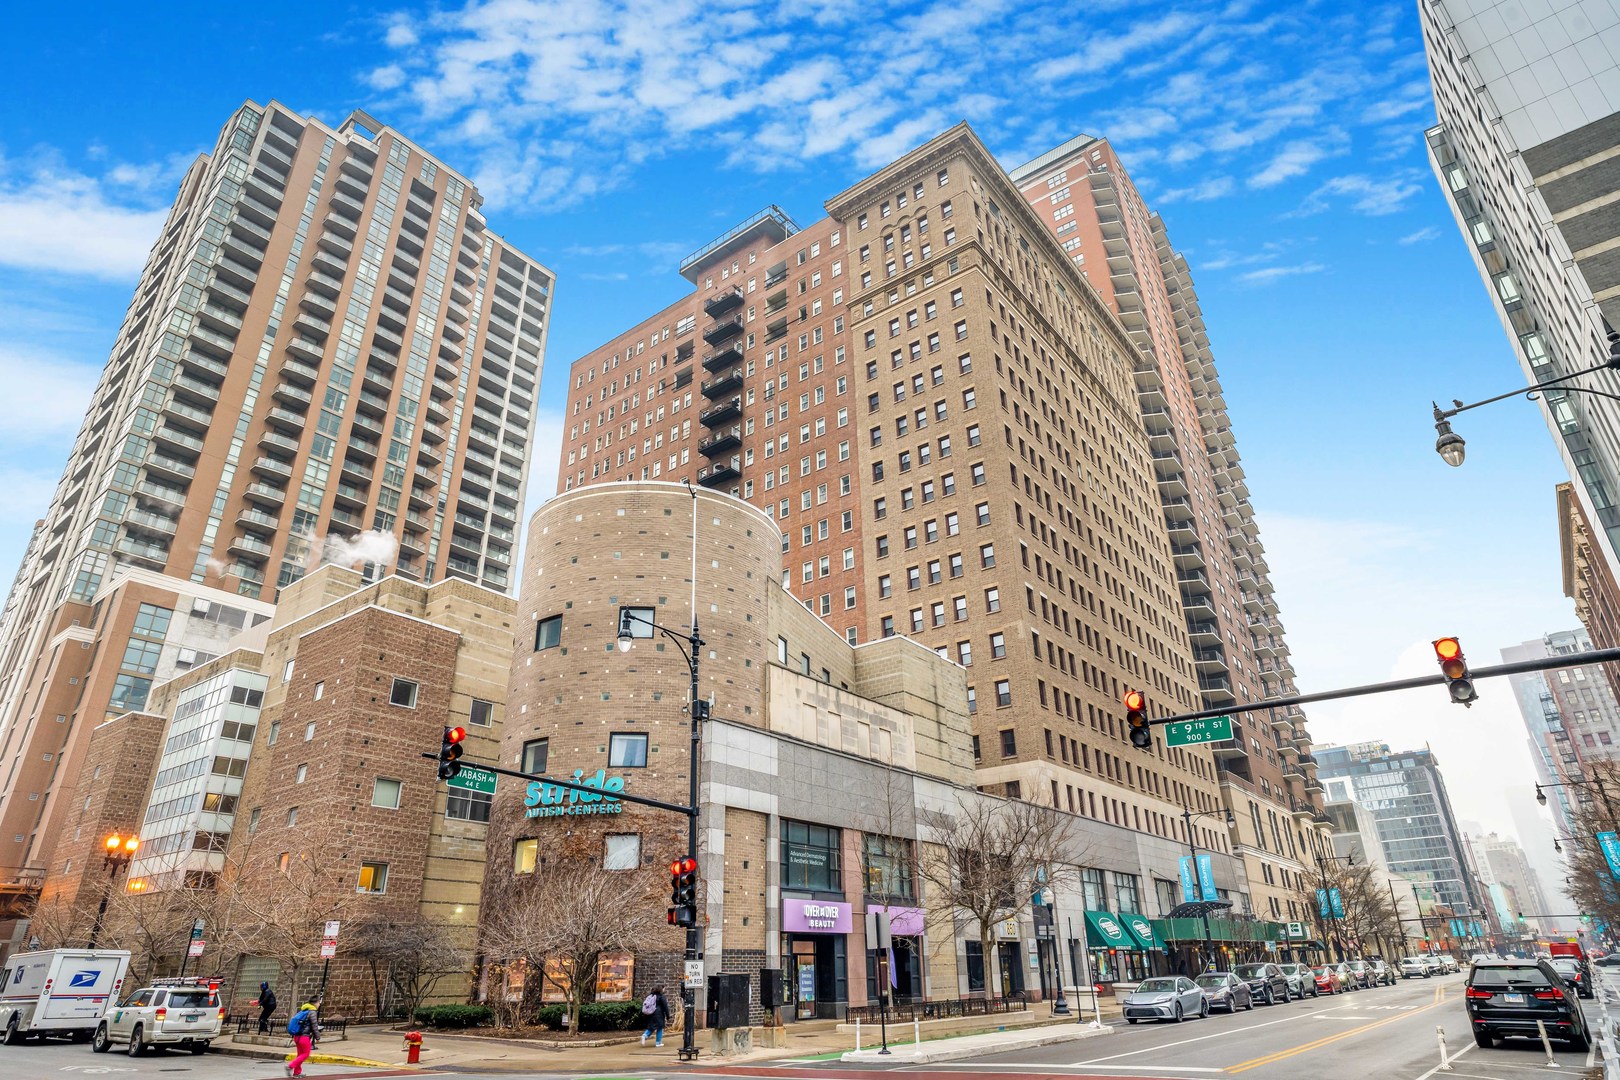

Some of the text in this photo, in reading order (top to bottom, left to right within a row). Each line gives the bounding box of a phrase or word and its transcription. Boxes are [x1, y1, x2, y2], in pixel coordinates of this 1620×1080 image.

[1184, 722, 1205, 733] 9TH
[1212, 720, 1223, 729] ST
[1186, 731, 1211, 741] 900 S
[524, 768, 626, 807] stride
[525, 803, 623, 819] AUTISM CENTERS
[790, 850, 807, 858] Advanced
[804, 904, 820, 917] OVER
[825, 906, 839, 918] OVER
[809, 919, 835, 928] BEAUTY
